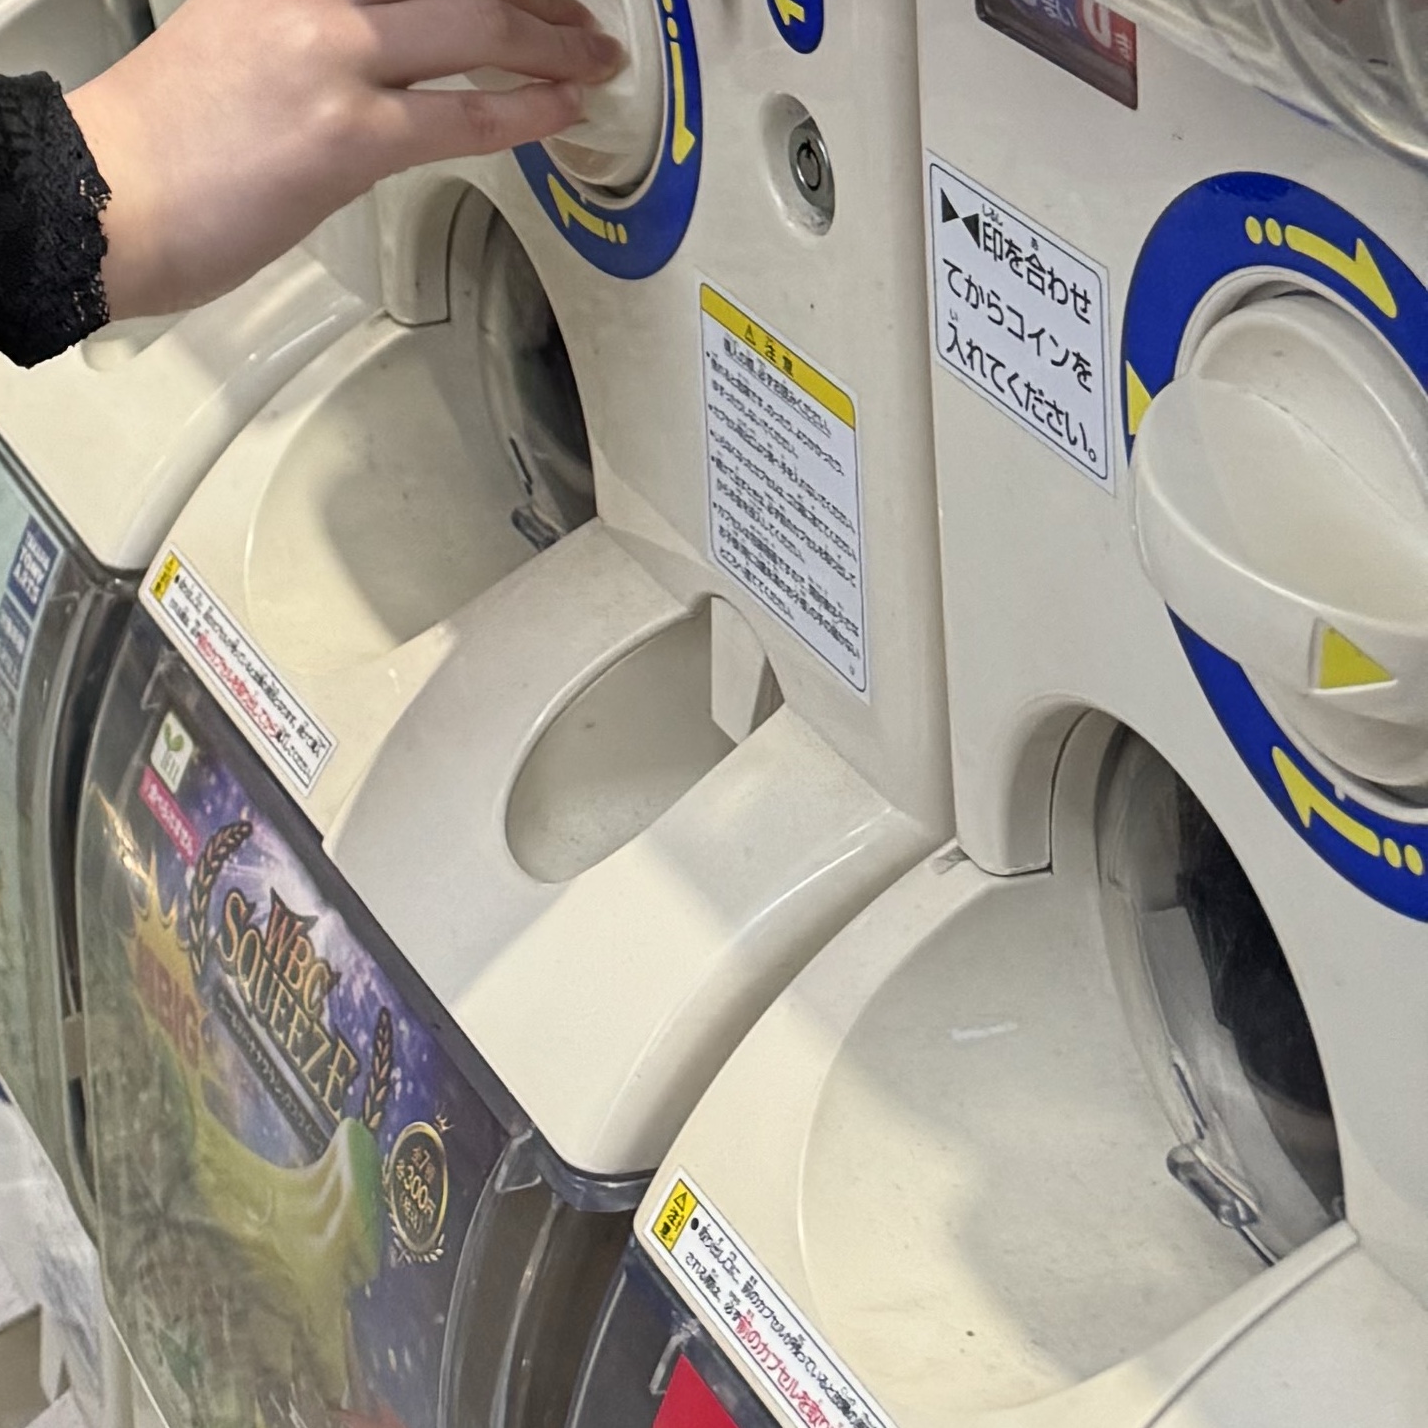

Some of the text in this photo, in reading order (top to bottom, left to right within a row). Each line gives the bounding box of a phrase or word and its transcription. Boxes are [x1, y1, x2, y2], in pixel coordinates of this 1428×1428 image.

[942, 257, 1092, 393] てからコインを
[983, 222, 1091, 325] 印を合わせ
[946, 321, 1097, 463] 入れてください。
